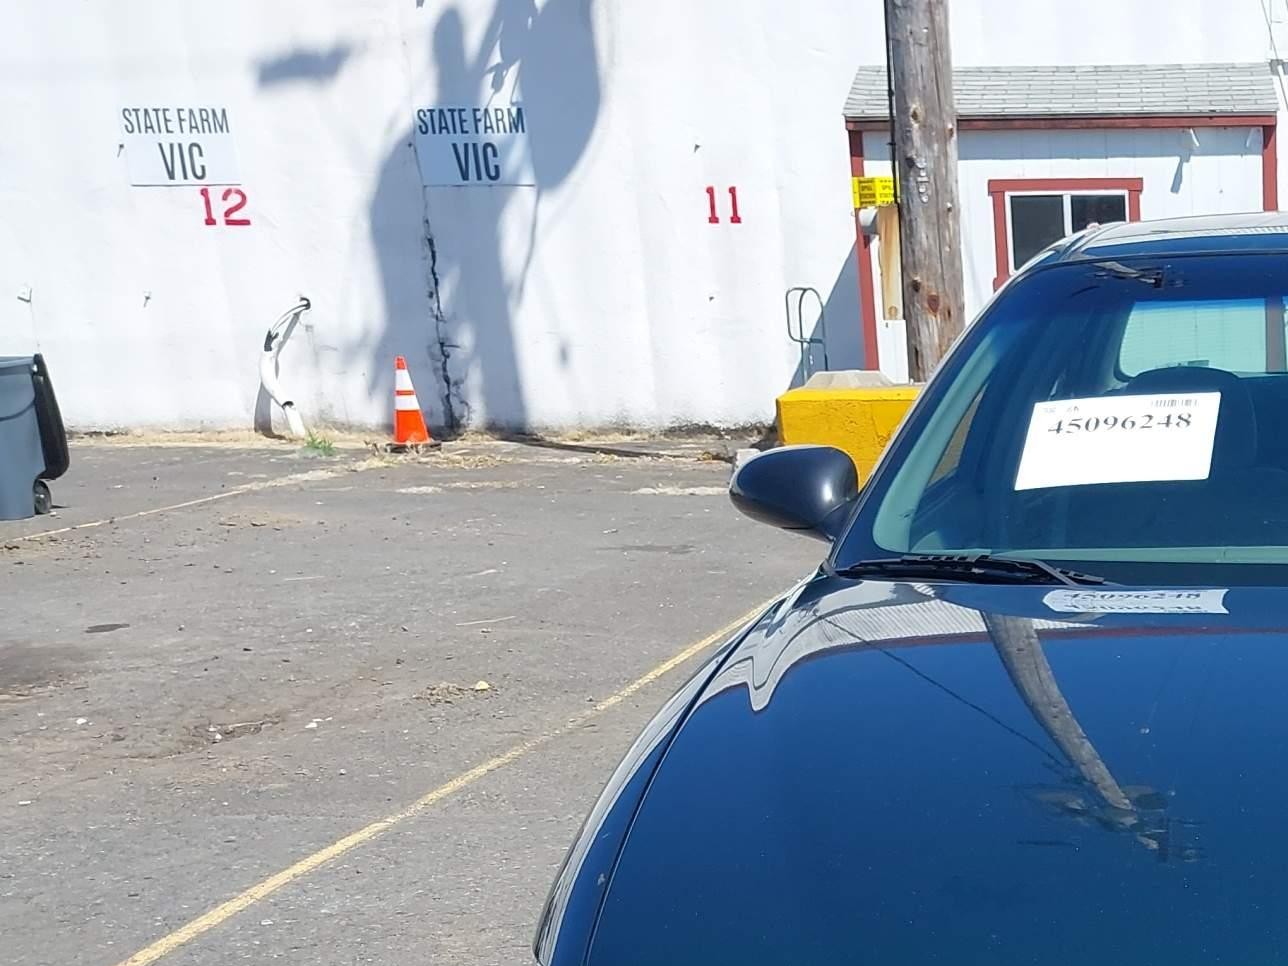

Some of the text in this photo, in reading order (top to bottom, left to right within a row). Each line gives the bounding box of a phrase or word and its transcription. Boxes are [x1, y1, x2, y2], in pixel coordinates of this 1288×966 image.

[122, 108, 230, 134] STATE FARM
[417, 107, 525, 135] STATE FARM
[158, 142, 206, 180] VIC
[452, 142, 500, 181] VIC
[200, 188, 251, 225] 12
[706, 186, 742, 224] 11
[1048, 413, 1192, 434] 45096248
